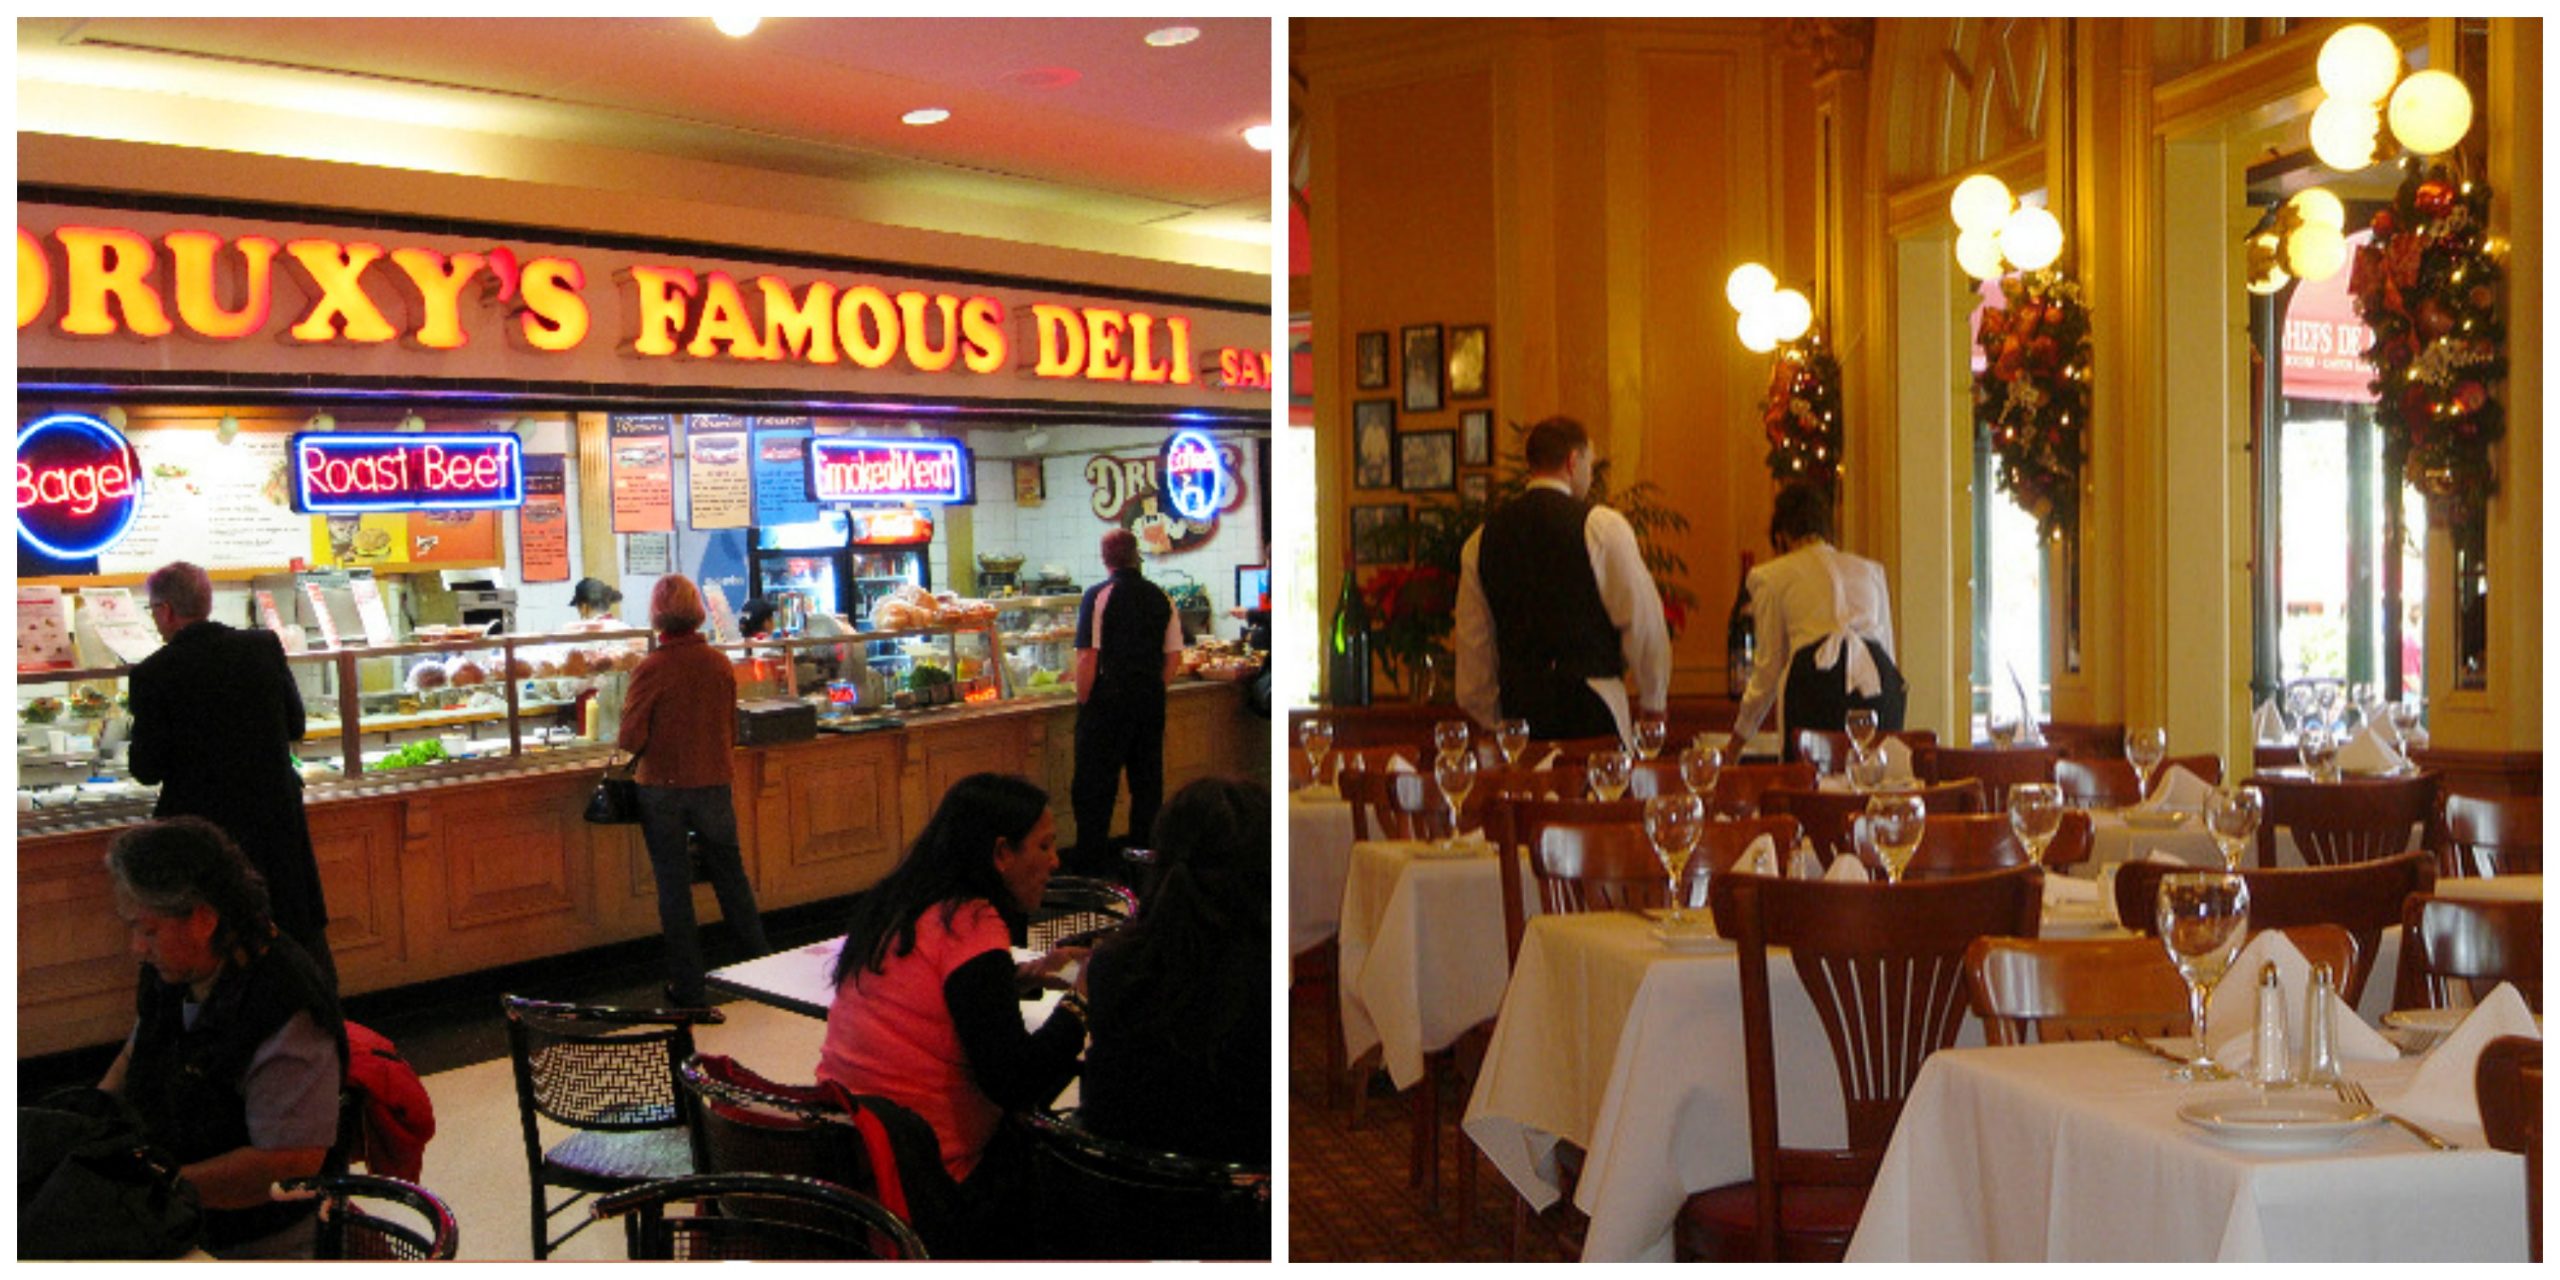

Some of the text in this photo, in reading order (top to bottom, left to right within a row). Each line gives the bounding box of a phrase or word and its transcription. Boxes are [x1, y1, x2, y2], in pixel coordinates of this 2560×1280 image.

[632, 265, 1006, 373] FAMOUS
[1032, 304, 1192, 385] DELI
[2282, 319, 2333, 354] HEFS
[17, 446, 135, 514] Bagel
[304, 443, 508, 493] Roast Beef
